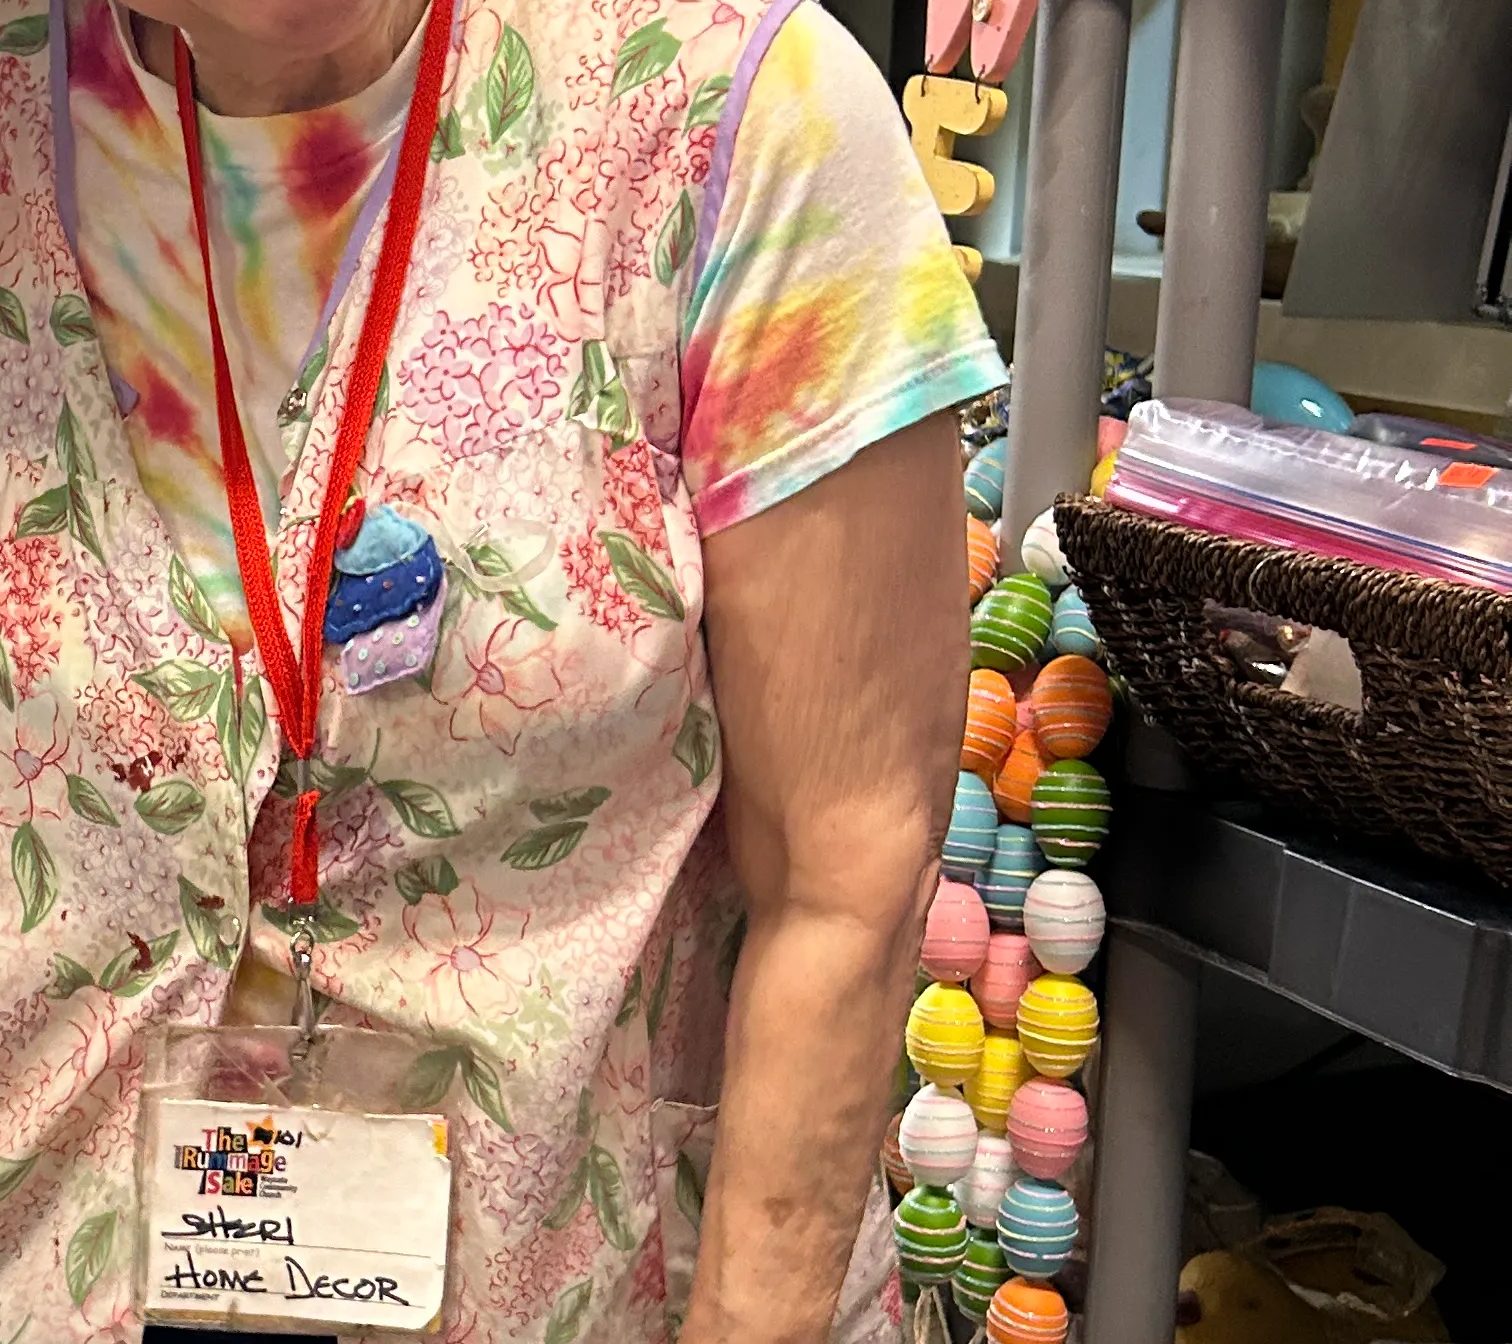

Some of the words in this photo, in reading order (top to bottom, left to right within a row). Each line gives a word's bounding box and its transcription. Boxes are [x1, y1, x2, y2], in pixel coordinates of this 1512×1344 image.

[201, 1126, 248, 1152] The
[173, 1144, 287, 1175] Rummage
[199, 1169, 257, 1197] Sale
